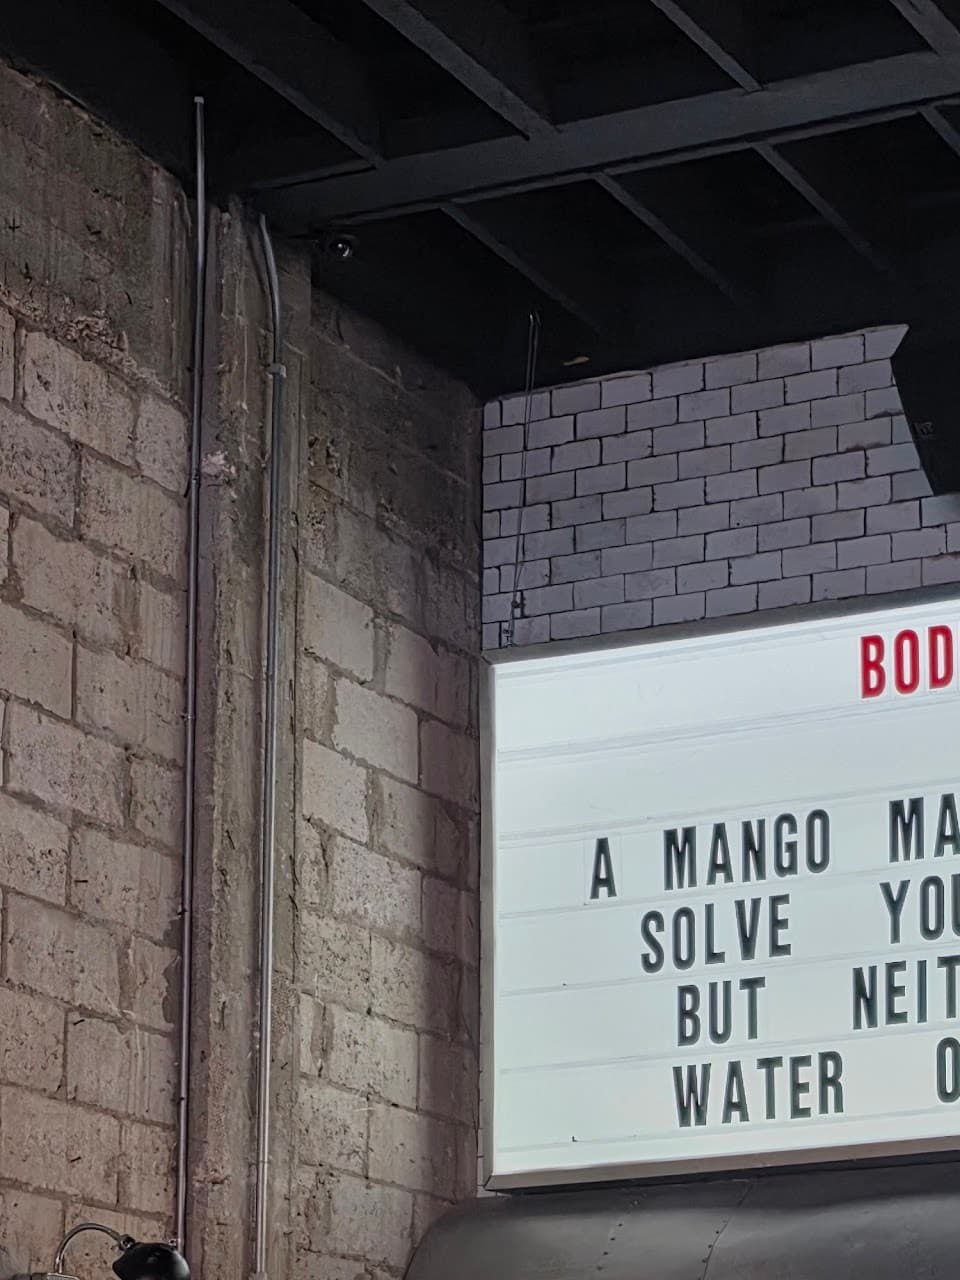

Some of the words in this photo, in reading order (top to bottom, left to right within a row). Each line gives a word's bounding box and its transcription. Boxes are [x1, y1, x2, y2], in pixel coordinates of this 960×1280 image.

[590, 837, 617, 900] A
[663, 809, 830, 891] MANGO
[640, 893, 792, 974] SOLVE
[677, 976, 766, 1047] BUT
[672, 1051, 844, 1128] WATER
